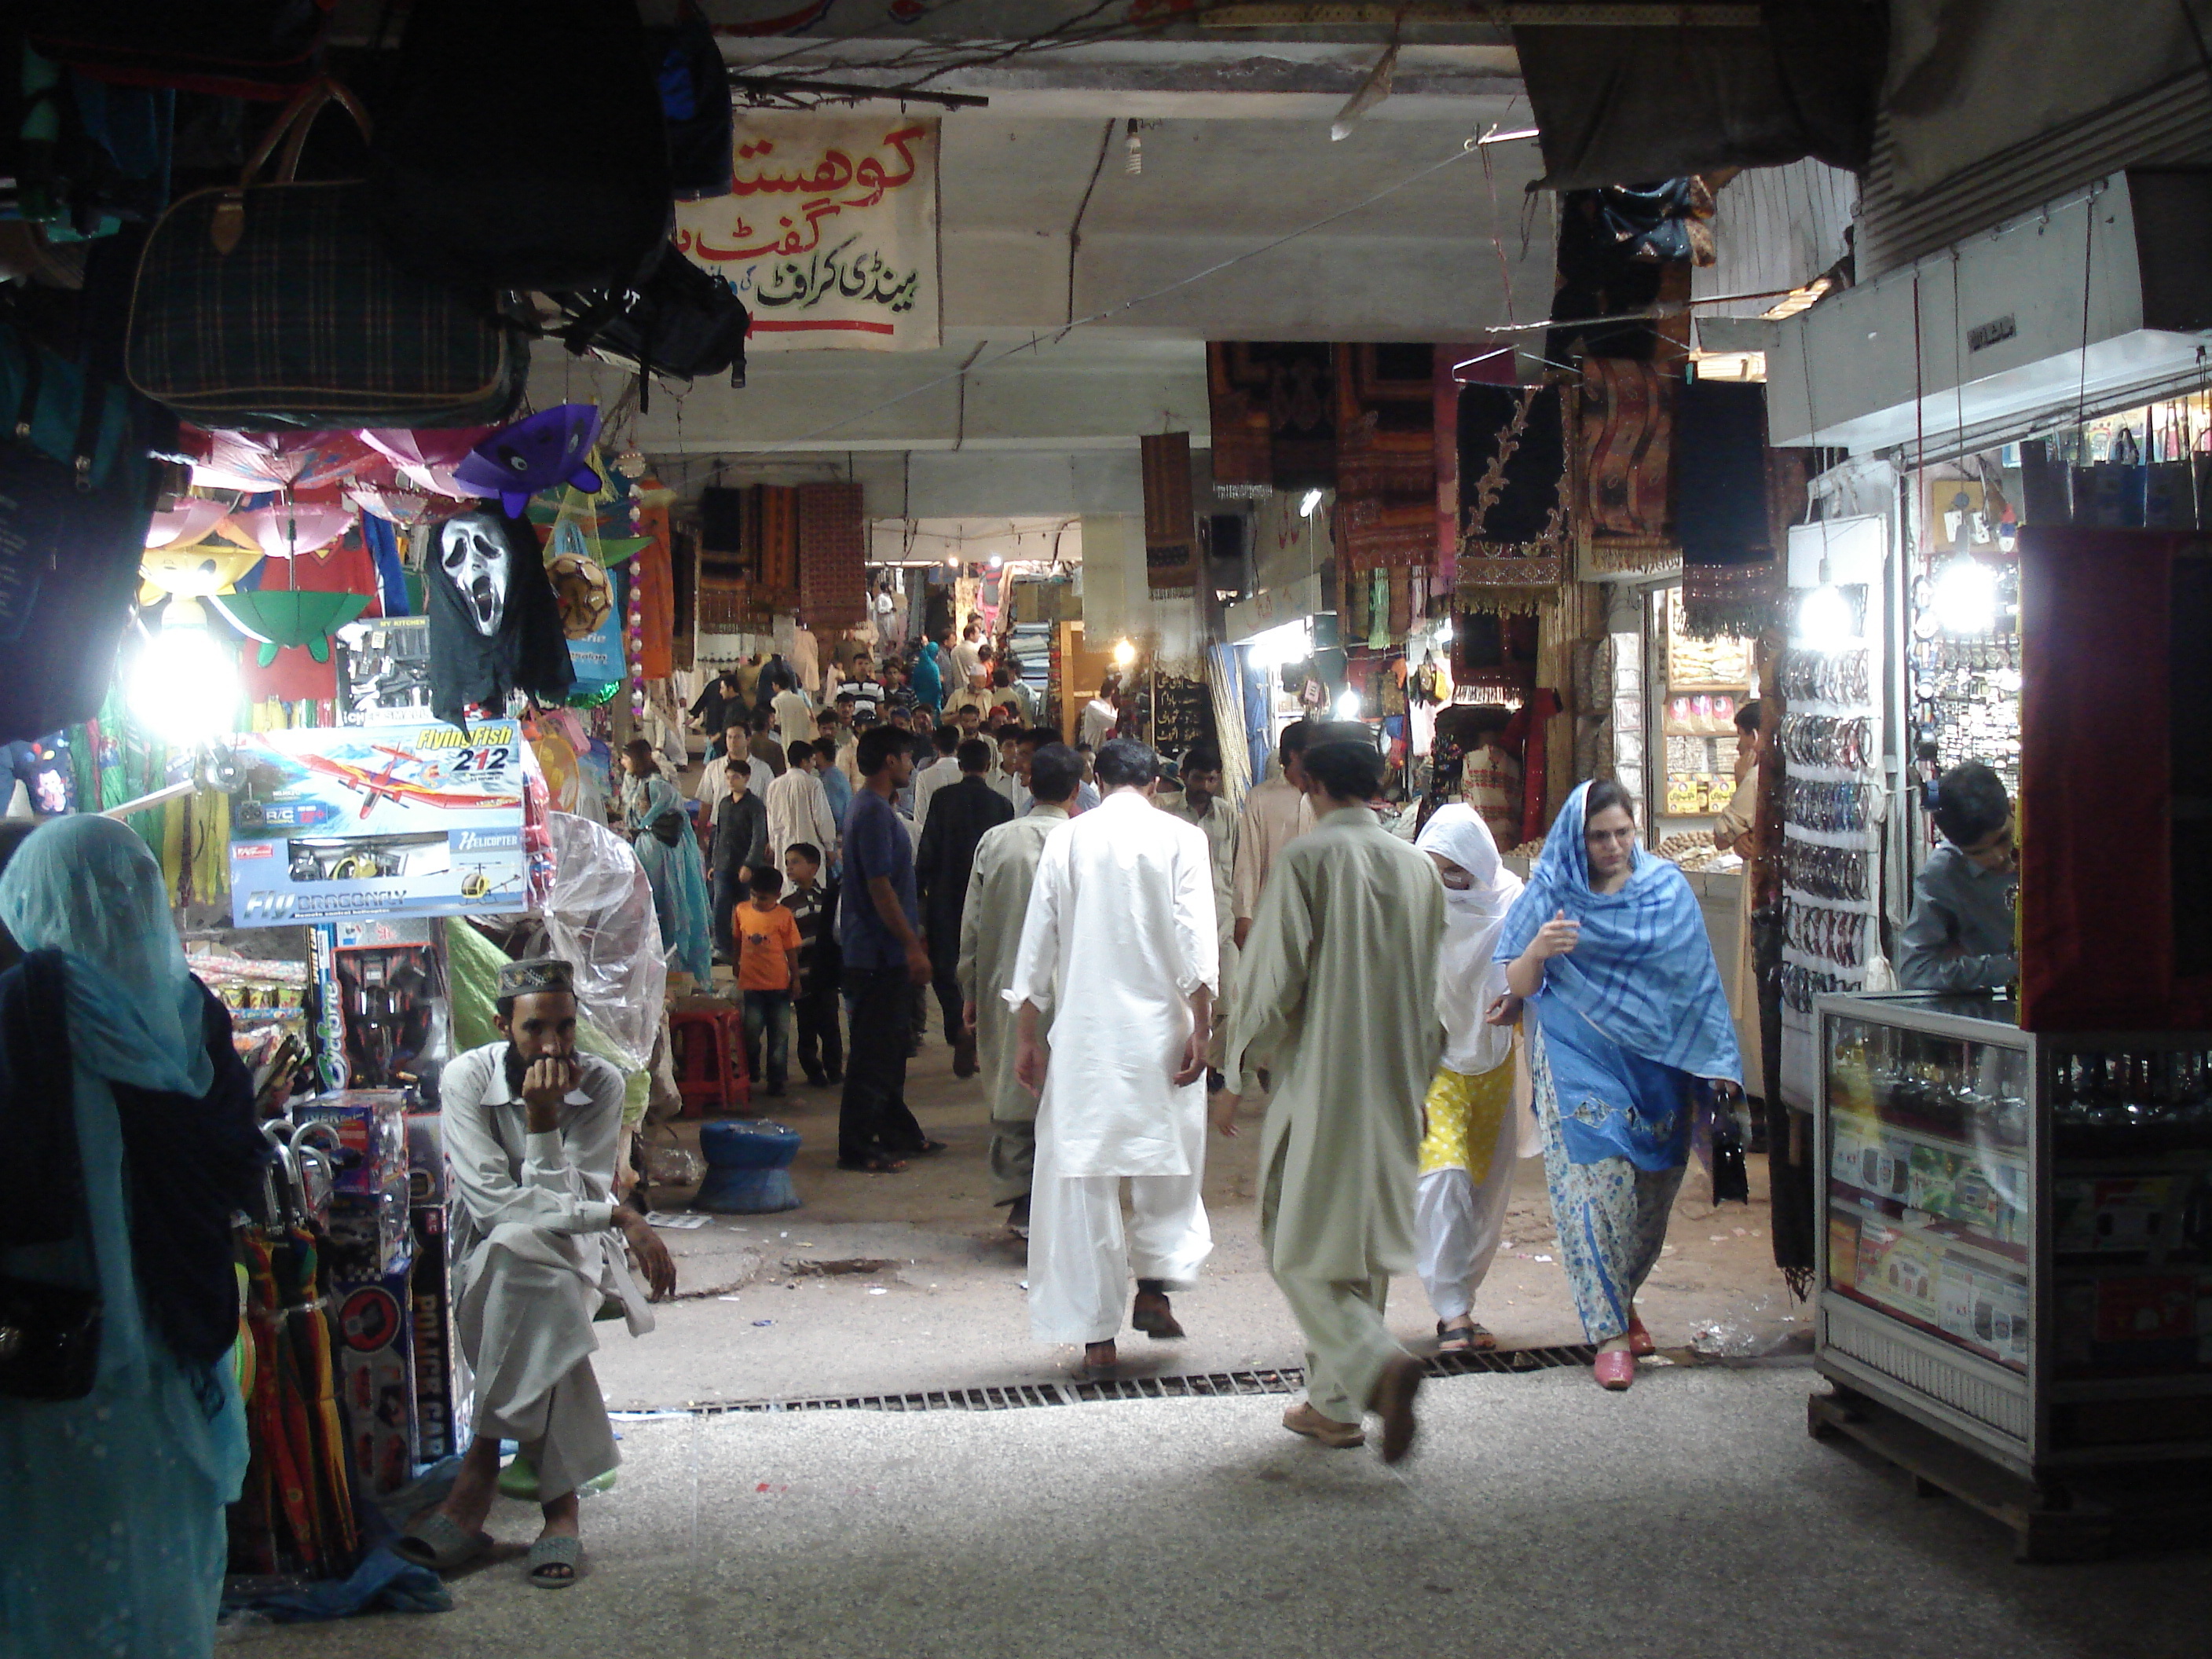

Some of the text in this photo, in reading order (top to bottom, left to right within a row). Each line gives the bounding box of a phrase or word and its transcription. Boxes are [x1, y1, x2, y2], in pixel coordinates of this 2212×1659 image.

[696, 197, 841, 262] گفٹ
[756, 235, 857, 309] کرافٹ
[452, 747, 509, 771] 212
[266, 810, 294, 820] R/C
[459, 831, 518, 850] HELICOPTER
[244, 890, 296, 920] Fly
[298, 890, 407, 910] DRAGONFLY
[317, 981, 346, 1090] Cyclone
[413, 1294, 445, 1457] POLICE CAR
